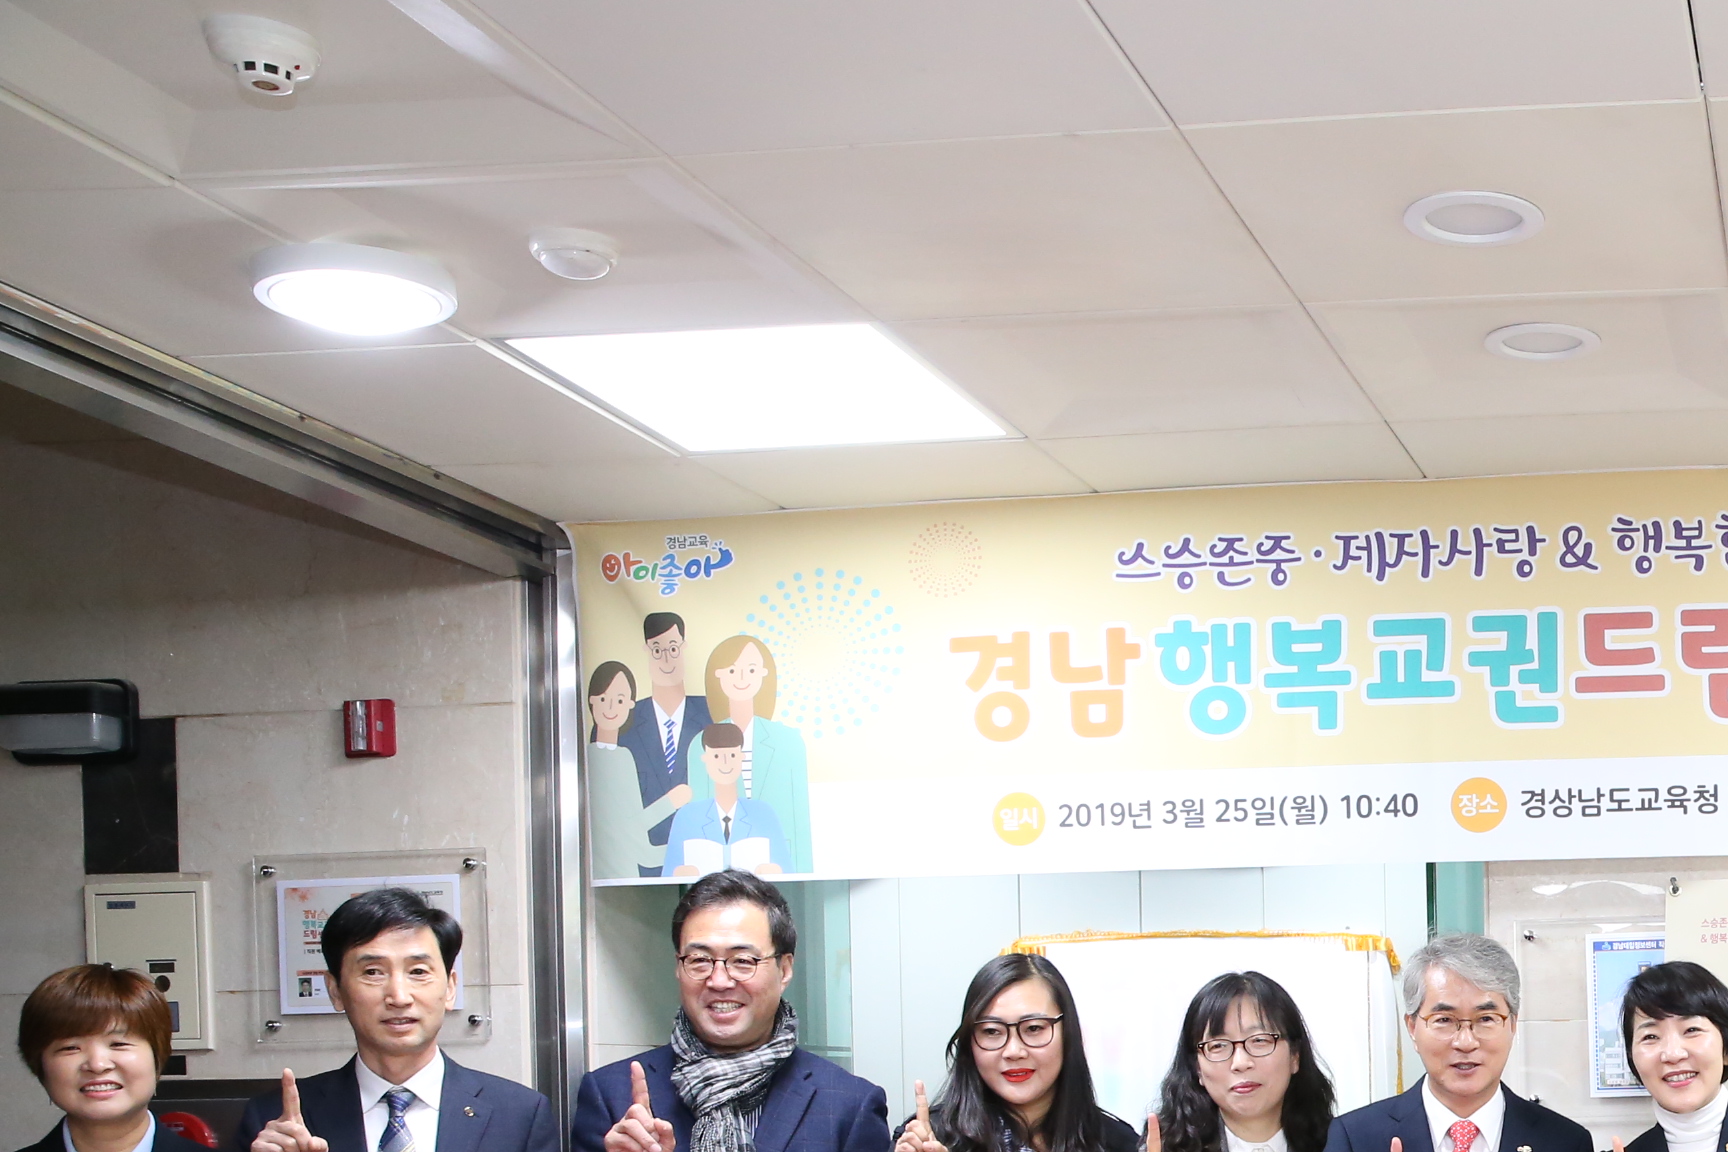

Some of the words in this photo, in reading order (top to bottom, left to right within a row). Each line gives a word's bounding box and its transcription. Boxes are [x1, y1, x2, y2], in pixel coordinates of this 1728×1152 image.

[666, 535, 709, 550] 경남교육
[1559, 534, 1599, 573] &
[602, 541, 734, 597] 아이좋아
[1058, 799, 1154, 832] 2019년
[1162, 798, 1206, 829] 3월
[1215, 794, 1331, 829] 25일(월)
[1339, 792, 1420, 823] 10:40
[1458, 793, 1499, 817] 장소
[1520, 788, 1722, 818] 경상남도교육청
[999, 807, 1040, 831] 일시
[1700, 933, 1708, 944] &
